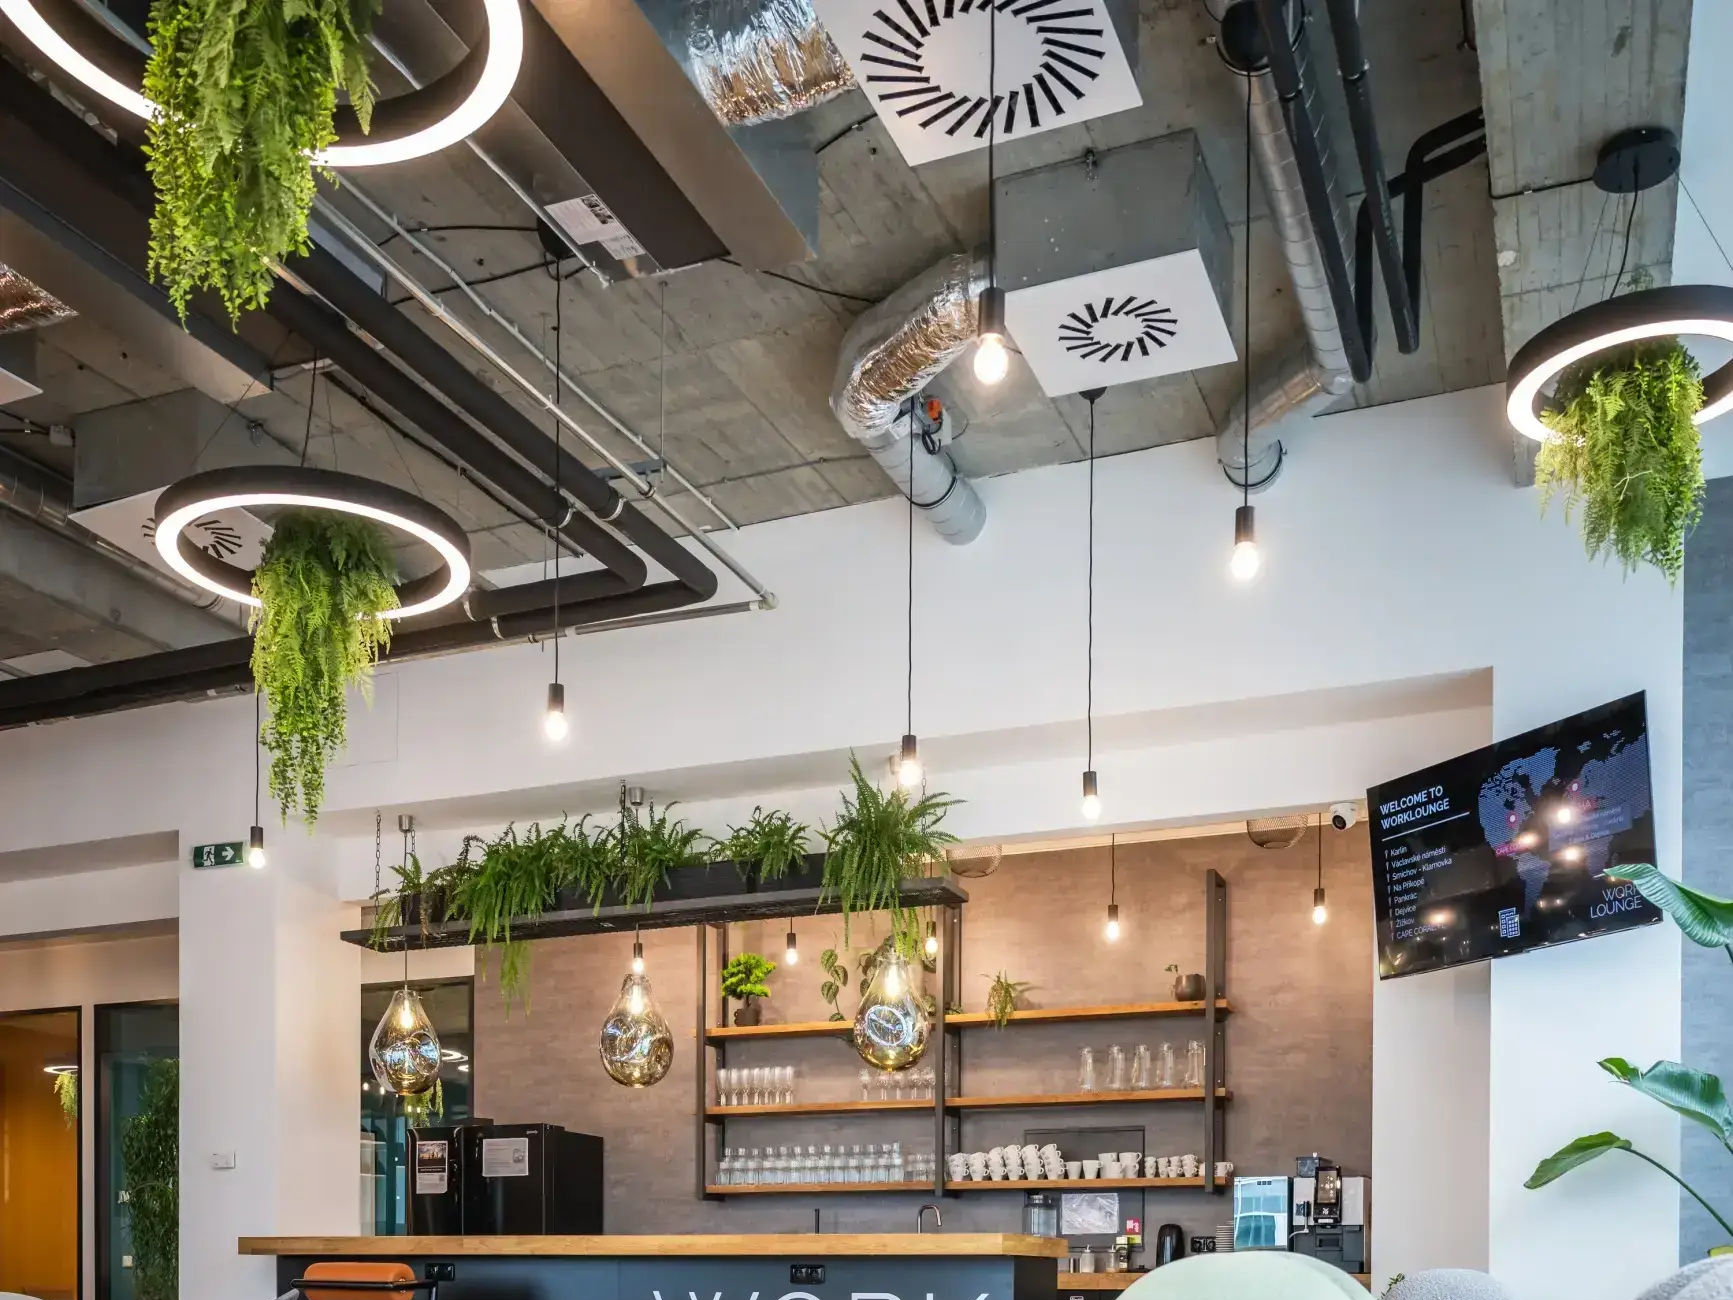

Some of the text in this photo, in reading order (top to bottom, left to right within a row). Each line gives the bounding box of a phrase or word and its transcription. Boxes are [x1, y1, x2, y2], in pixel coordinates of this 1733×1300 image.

[1380, 785, 1443, 815] WELCOME TO
[1381, 798, 1450, 829] WORKLOUNGE
[1393, 884, 1401, 892] Na
[1395, 905, 1417, 916] Dejvice
[1590, 895, 1642, 918] LOUNGE
[1396, 929, 1413, 939] CAPE
